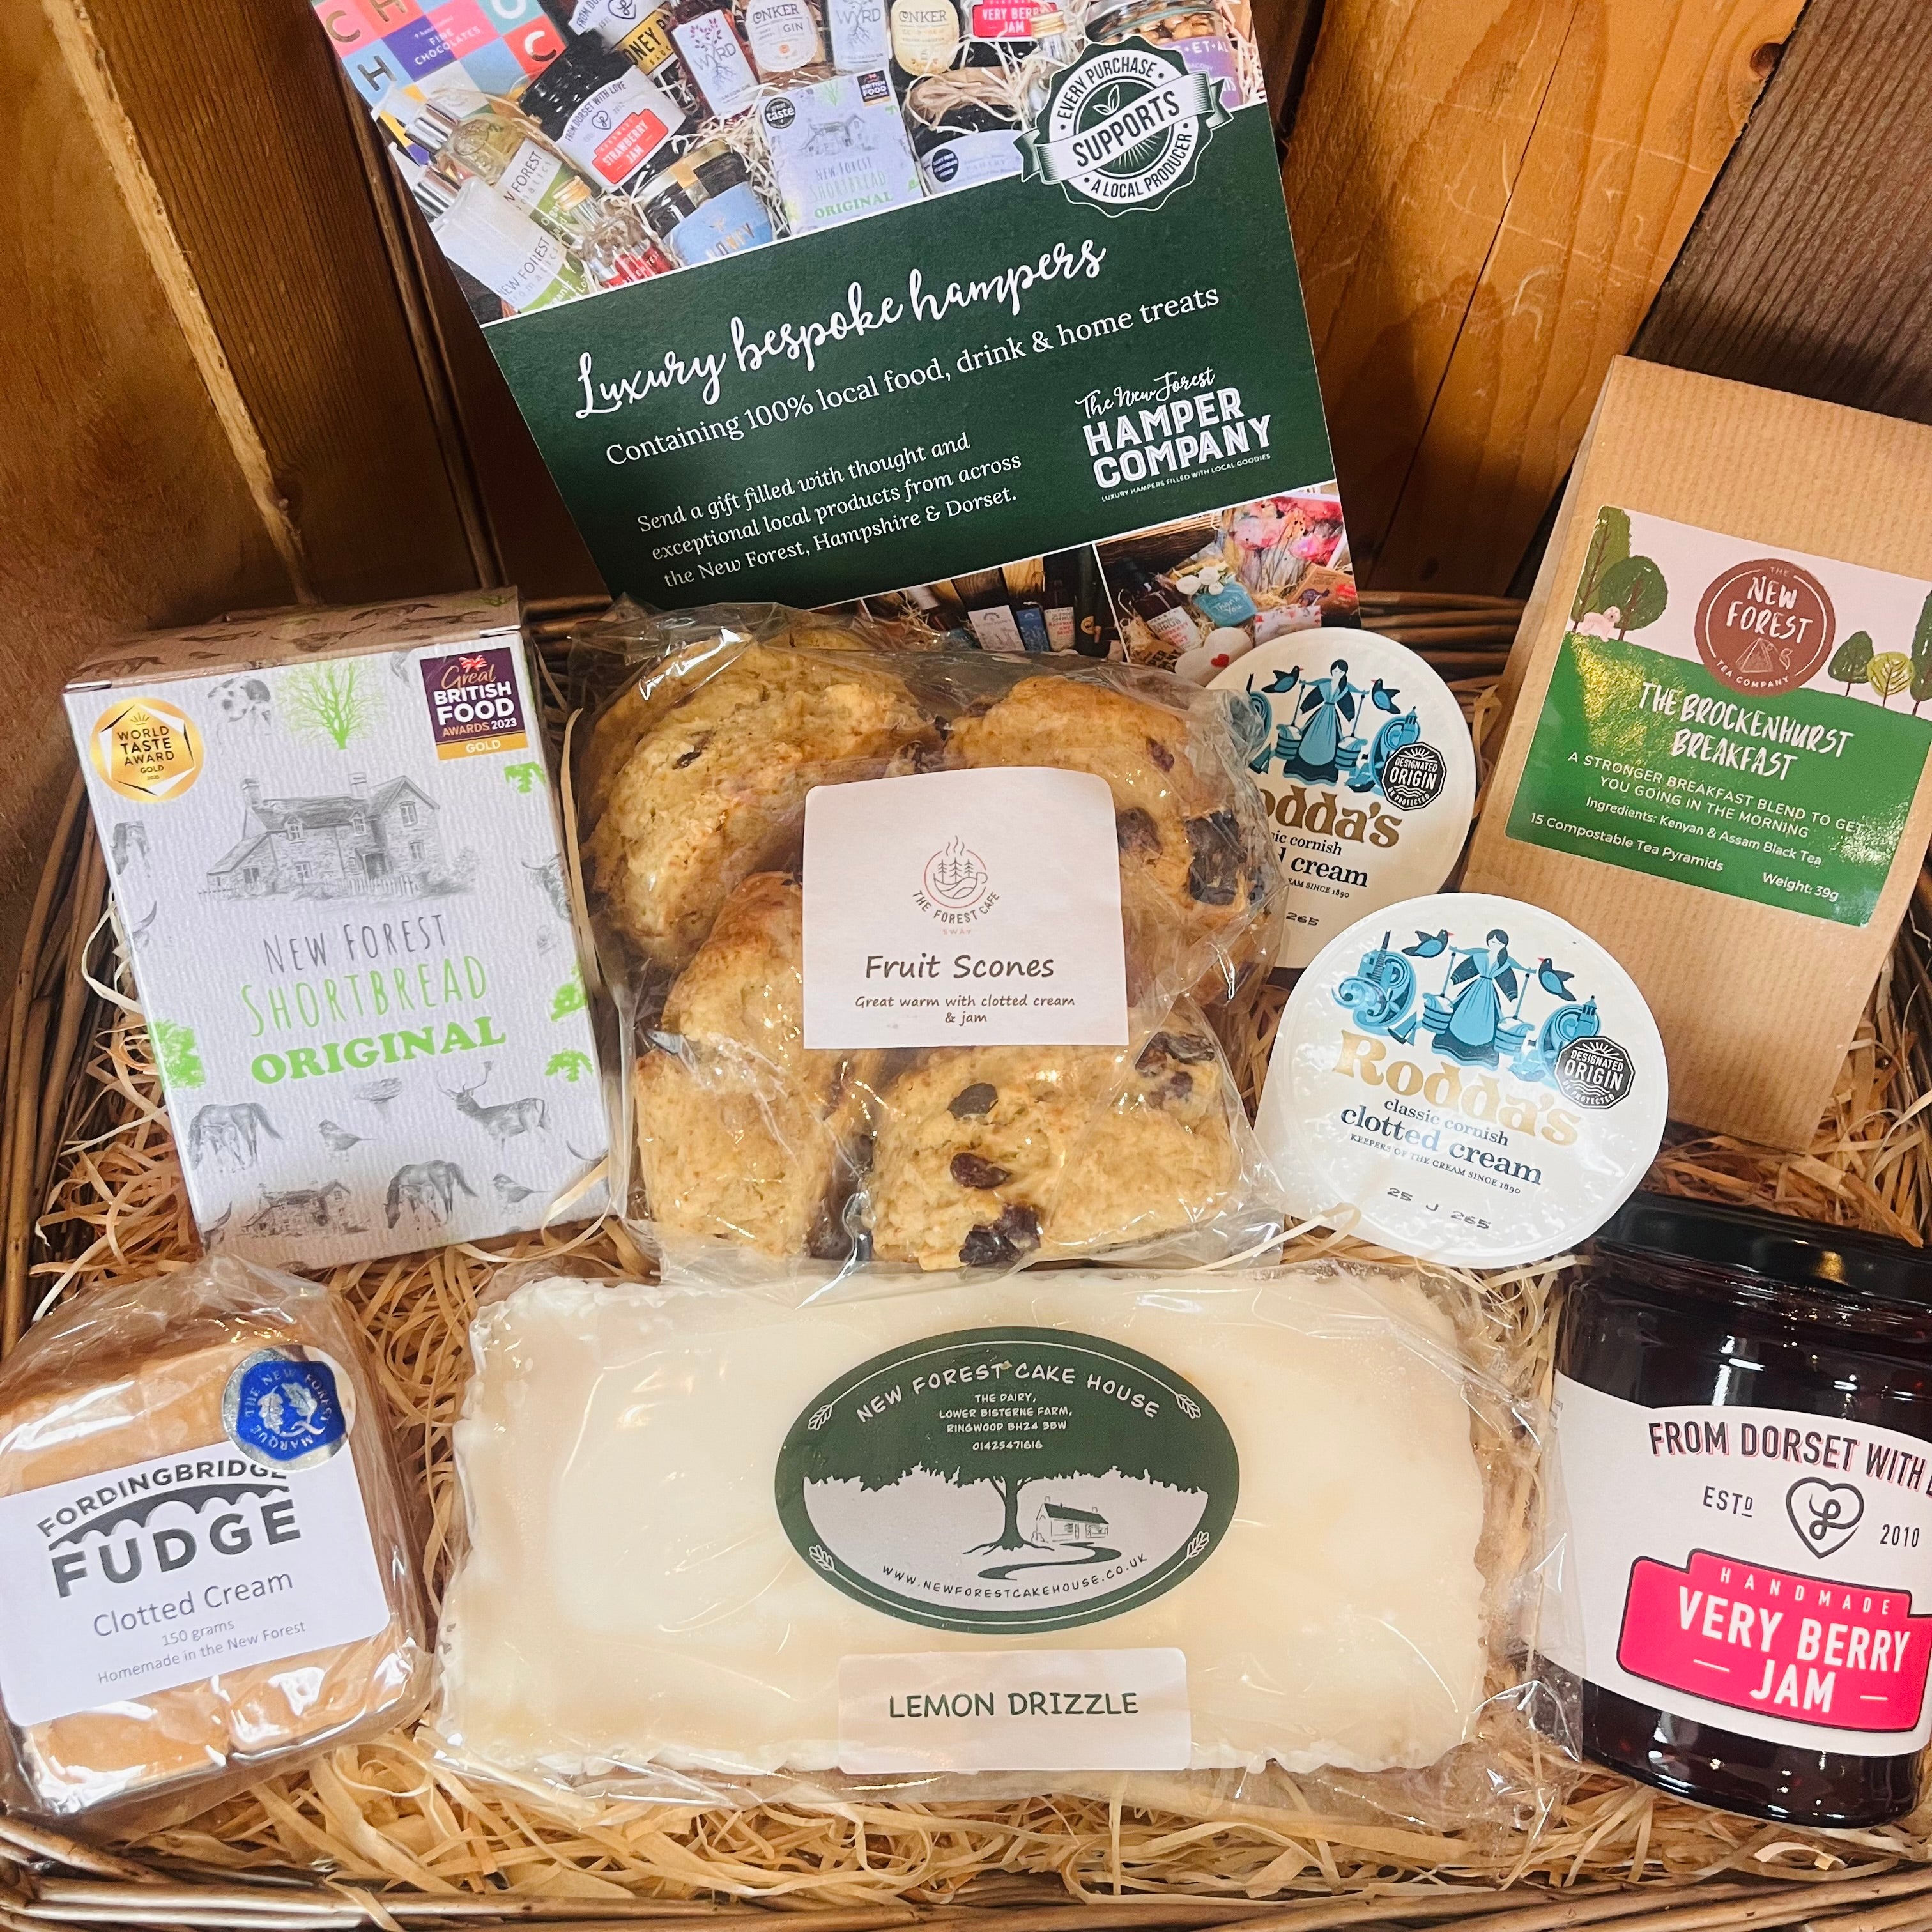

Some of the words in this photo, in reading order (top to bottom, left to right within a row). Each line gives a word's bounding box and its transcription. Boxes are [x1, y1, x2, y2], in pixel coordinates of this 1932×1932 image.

[415, 26, 481, 65] CHOCOLATES
[1057, 76, 1087, 119] EVERY
[1086, 56, 1157, 84] PURCHASE
[766, 107, 795, 121] taste
[1073, 90, 1180, 167] SUPPORTS
[602, 120, 649, 166] STRAWBERRY
[1091, 179, 1102, 194] A
[1103, 183, 1144, 198] LOCAL
[1146, 133, 1192, 192] PRODUCER
[511, 151, 542, 193] FOREST
[815, 192, 894, 218] ORIGINAL
[575, 352, 726, 419] Luxury
[730, 282, 903, 372] bespoke
[909, 239, 1107, 321] hampers
[606, 416, 744, 464] Containing
[744, 395, 813, 430] 100%
[816, 374, 880, 411] local
[883, 358, 951, 392] food,
[956, 339, 1027, 372] drink
[1032, 331, 1054, 353] &
[1056, 312, 1133, 346] home
[1138, 288, 1220, 324] treats
[1075, 390, 1114, 418] The
[1114, 386, 1156, 408] New
[1153, 367, 1215, 402] Forest
[1082, 387, 1245, 456] HAMPER
[1093, 415, 1271, 489] COMPANY
[637, 506, 687, 532] Send
[691, 506, 703, 519] a
[707, 493, 741, 520] gift
[744, 478, 795, 511] filled
[797, 467, 845, 492] with
[847, 446, 926, 479] thought
[931, 432, 970, 457] and
[1101, 489, 1129, 502] LUXURY
[1130, 480, 1165, 494] HAMPERS
[1166, 475, 1190, 486] FILLED
[1192, 469, 1210, 479] WITH
[1211, 462, 1235, 473] LOCAL
[1236, 453, 1271, 467] GOODIES
[652, 519, 761, 560] exceptional
[762, 507, 811, 533] local
[814, 487, 901, 525] products
[905, 474, 954, 502] from
[958, 456, 1022, 482] across
[664, 571, 694, 587] the
[697, 558, 741, 579] New
[745, 542, 810, 568] Forest,
[813, 514, 921, 551] Hampshire
[925, 506, 941, 522] &
[946, 487, 1017, 518] Dorset.
[1747, 576, 1798, 610] NEW
[1726, 600, 1813, 643] FOREST
[433, 681, 512, 705] BRITISH
[441, 664, 496, 689] Great
[1716, 660, 1732, 677] TEA
[1736, 675, 1789, 688] COMPANY
[117, 726, 169, 740] WORLD
[437, 698, 514, 726] FOOD
[443, 722, 490, 737] AWARDS
[491, 717, 517, 730] 2023
[1638, 682, 1678, 716] THE
[1680, 693, 1855, 758] BROCKENHURST
[121, 737, 172, 755] TASTE
[125, 751, 174, 766] AWARD
[1671, 728, 1798, 781] BREAKFAST
[1583, 755, 1663, 783] STRONGER
[1667, 776, 1754, 806] BREAKFAST
[1757, 799, 1806, 820] BLEND
[1811, 811, 1831, 826] TO
[1600, 776, 1630, 793] YOU
[1634, 785, 1682, 806] GOING
[1685, 797, 1702, 811] IN
[1706, 802, 1735, 820] THE
[1738, 811, 1809, 838] MORNING
[1290, 836, 1342, 855] cornish
[1530, 812, 1544, 825] 15
[1546, 817, 1634, 848] Compostable
[1637, 839, 1659, 855] Tea
[1662, 847, 1724, 871] Pyramids
[1586, 796, 1657, 824] Ingredients:
[1659, 815, 1704, 836] Kenyan
[1719, 831, 1760, 850] Assam
[1763, 841, 1797, 859] Black
[1800, 850, 1822, 866] Tea
[1291, 857, 1368, 887] cream
[1762, 871, 1813, 894] Weight:
[1814, 885, 1840, 903] 39g
[912, 890, 932, 912] THE
[933, 909, 977, 924] FOREST
[979, 891, 1000, 914] CAFE
[263, 932, 327, 974] NEW
[344, 914, 446, 961] FOREST
[866, 953, 941, 978] Fruit
[954, 954, 1054, 979] Scones
[241, 955, 486, 1038] SHORTBREAD
[855, 996, 894, 1008] Great
[900, 997, 939, 1007] warm
[946, 995, 976, 1007] with
[981, 994, 1028, 1007] clotted
[1033, 997, 1075, 1006] cream
[959, 1011, 987, 1026] jam
[251, 1016, 506, 1084] ORIGINAL
[1571, 1049, 1623, 1072] DESIGNATED
[1333, 1029, 1581, 1146] Rodda's
[1564, 1059, 1623, 1091] ORIGIN
[1341, 1105, 1441, 1151] clotted
[1449, 1142, 1542, 1185] cream
[1384, 1099, 1439, 1125] classic
[1445, 1119, 1508, 1146] cornish
[1350, 1133, 1391, 1152] KEEPERS
[1411, 1153, 1429, 1165] THE
[1432, 1160, 1465, 1176] CREAM
[1468, 1171, 1497, 1186] SINCE
[1499, 1183, 1521, 1194] 1890
[856, 1385, 902, 1423] NEW
[912, 1362, 1004, 1395] FOREST
[1015, 1363, 1075, 1384] CAKE
[1087, 1374, 1160, 1418] HOUSE
[939, 1409, 976, 1419] LOWER
[981, 1407, 1034, 1418] BISTERNE
[1038, 1406, 1073, 1416] FARM,
[974, 1393, 996, 1403] THE
[1000, 1393, 1036, 1404] DAIRY,
[947, 1423, 1003, 1433] RINGWOOD
[1008, 1422, 1038, 1431] BH24
[1043, 1420, 1067, 1430] 3BW
[972, 1440, 1043, 1451] 01425471616
[1649, 1420, 1729, 1456] FROM
[1741, 1423, 1859, 1471] DORSET
[1866, 1443, 1926, 1492] WITH
[50, 1499, 302, 1598] FUDGE
[1880, 1524, 1920, 1549] 2010
[883, 1553, 1147, 1598] WWW.NEWFORESTCAKEHOUSE.CO.UK
[1720, 1567, 1891, 1615] HANDMADE
[93, 1591, 195, 1636] Clotted
[204, 1573, 293, 1608] Cream
[98, 1655, 180, 1684] Homemade
[200, 1642, 224, 1658] the
[227, 1633, 259, 1651] New
[263, 1621, 306, 1641] Forest
[162, 1630, 188, 1646] 150
[192, 1620, 234, 1641] grams
[1679, 1586, 1784, 1653] VERY
[1797, 1618, 1910, 1673] BERRY
[889, 1692, 995, 1719] LEMON
[1007, 1691, 1138, 1717] DRIZZLE
[1750, 1659, 1836, 1713] JAM
